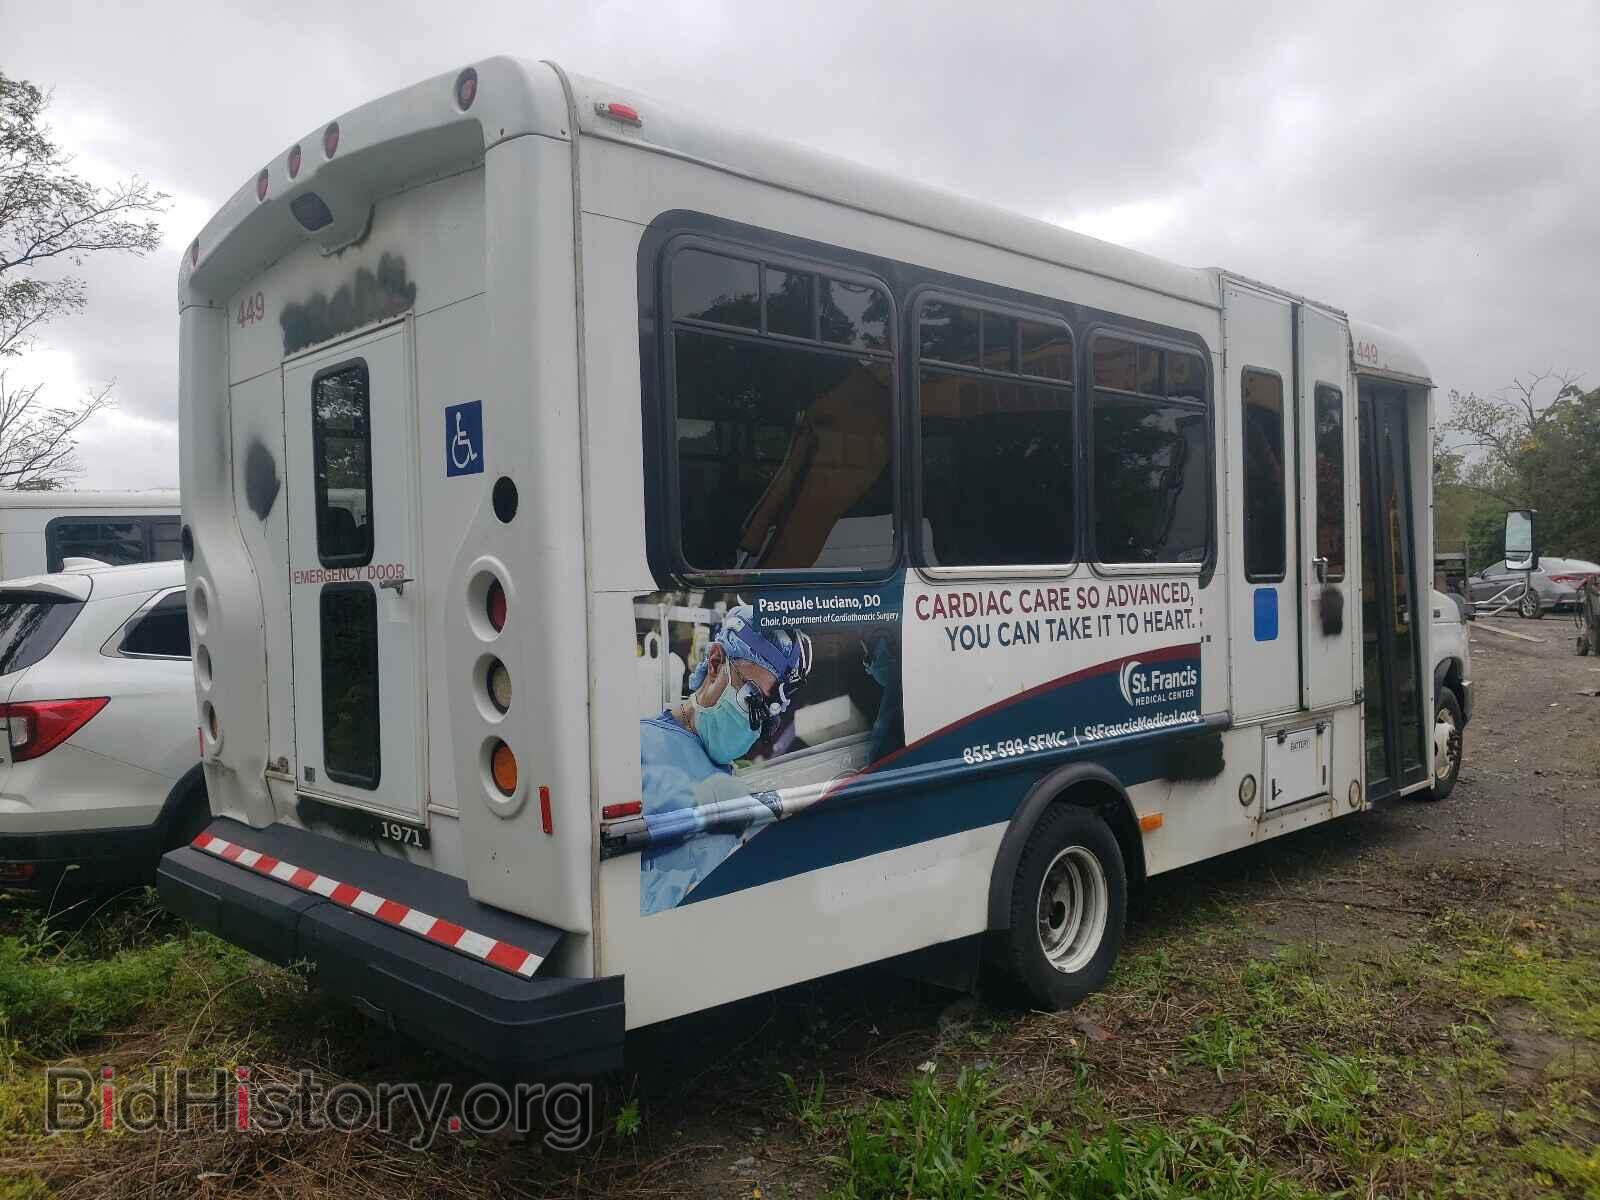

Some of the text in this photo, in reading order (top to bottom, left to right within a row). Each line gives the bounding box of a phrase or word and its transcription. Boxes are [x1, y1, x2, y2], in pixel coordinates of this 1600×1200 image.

[238, 291, 265, 328] 449
[1355, 341, 1378, 364] 449
[293, 564, 405, 585] EMERGENCY DOOR
[758, 594, 881, 614] Pasquale Luciano, DO
[915, 581, 1194, 620] CARDIAC CARE SO ADVANCED,
[760, 610, 899, 627] Chair, Department of Cardiothoracic Surgery
[944, 624, 991, 651] YOU
[997, 620, 1040, 647] CAN
[1045, 616, 1092, 642] TAKE
[1098, 614, 1112, 637] IT
[1116, 612, 1139, 635] TO
[1144, 608, 1195, 633] HEART.
[1132, 665, 1197, 694] St. Francis
[1135, 689, 1194, 707] MEDICAL CENTER
[963, 730, 1067, 764] 855-599-SFMC
[1084, 709, 1199, 740] StFrancisMedical.org
[381, 821, 424, 848] 1971
